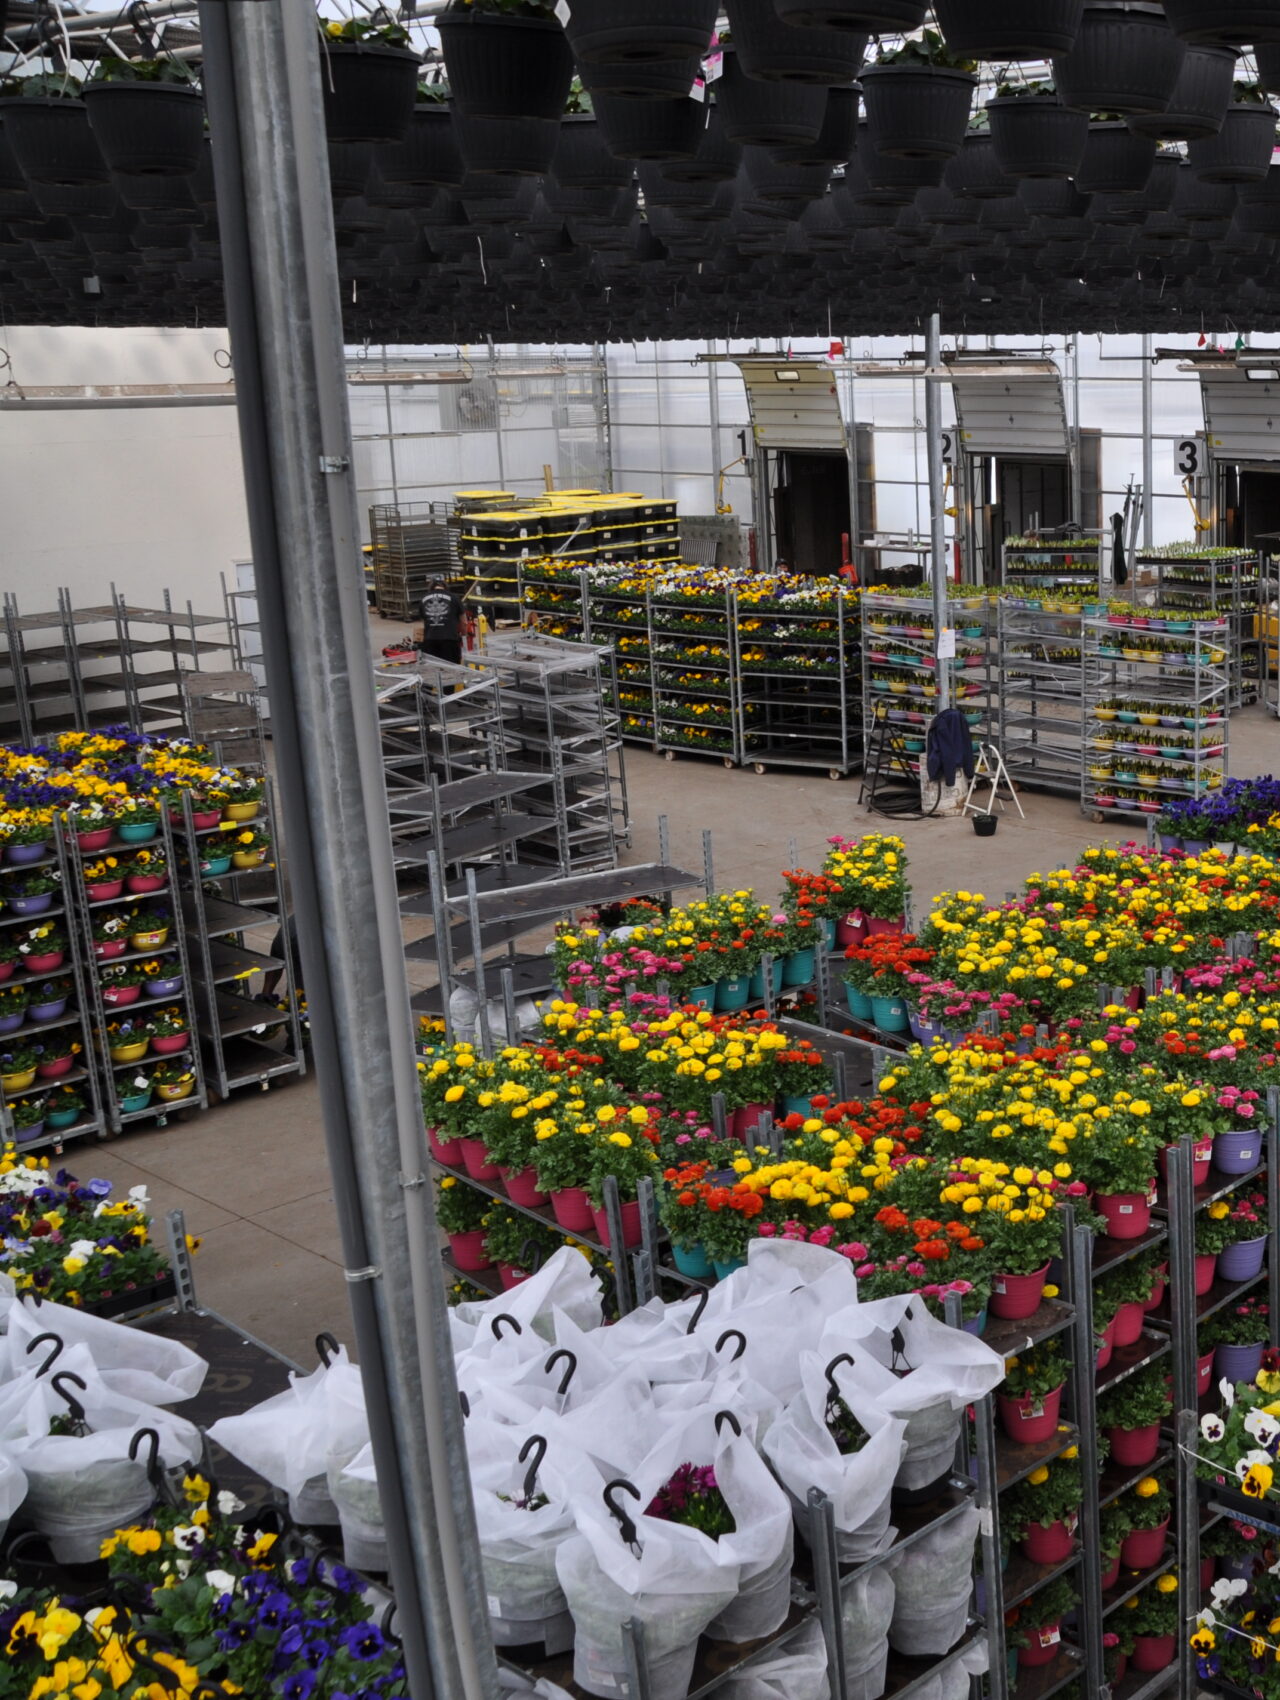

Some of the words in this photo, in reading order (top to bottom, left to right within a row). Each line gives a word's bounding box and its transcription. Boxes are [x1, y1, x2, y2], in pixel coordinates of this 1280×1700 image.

[736, 430, 747, 456] 1
[941, 434, 952, 463] 2
[1178, 442, 1199, 475] 3
[1226, 1509, 1263, 1527] ANDY
